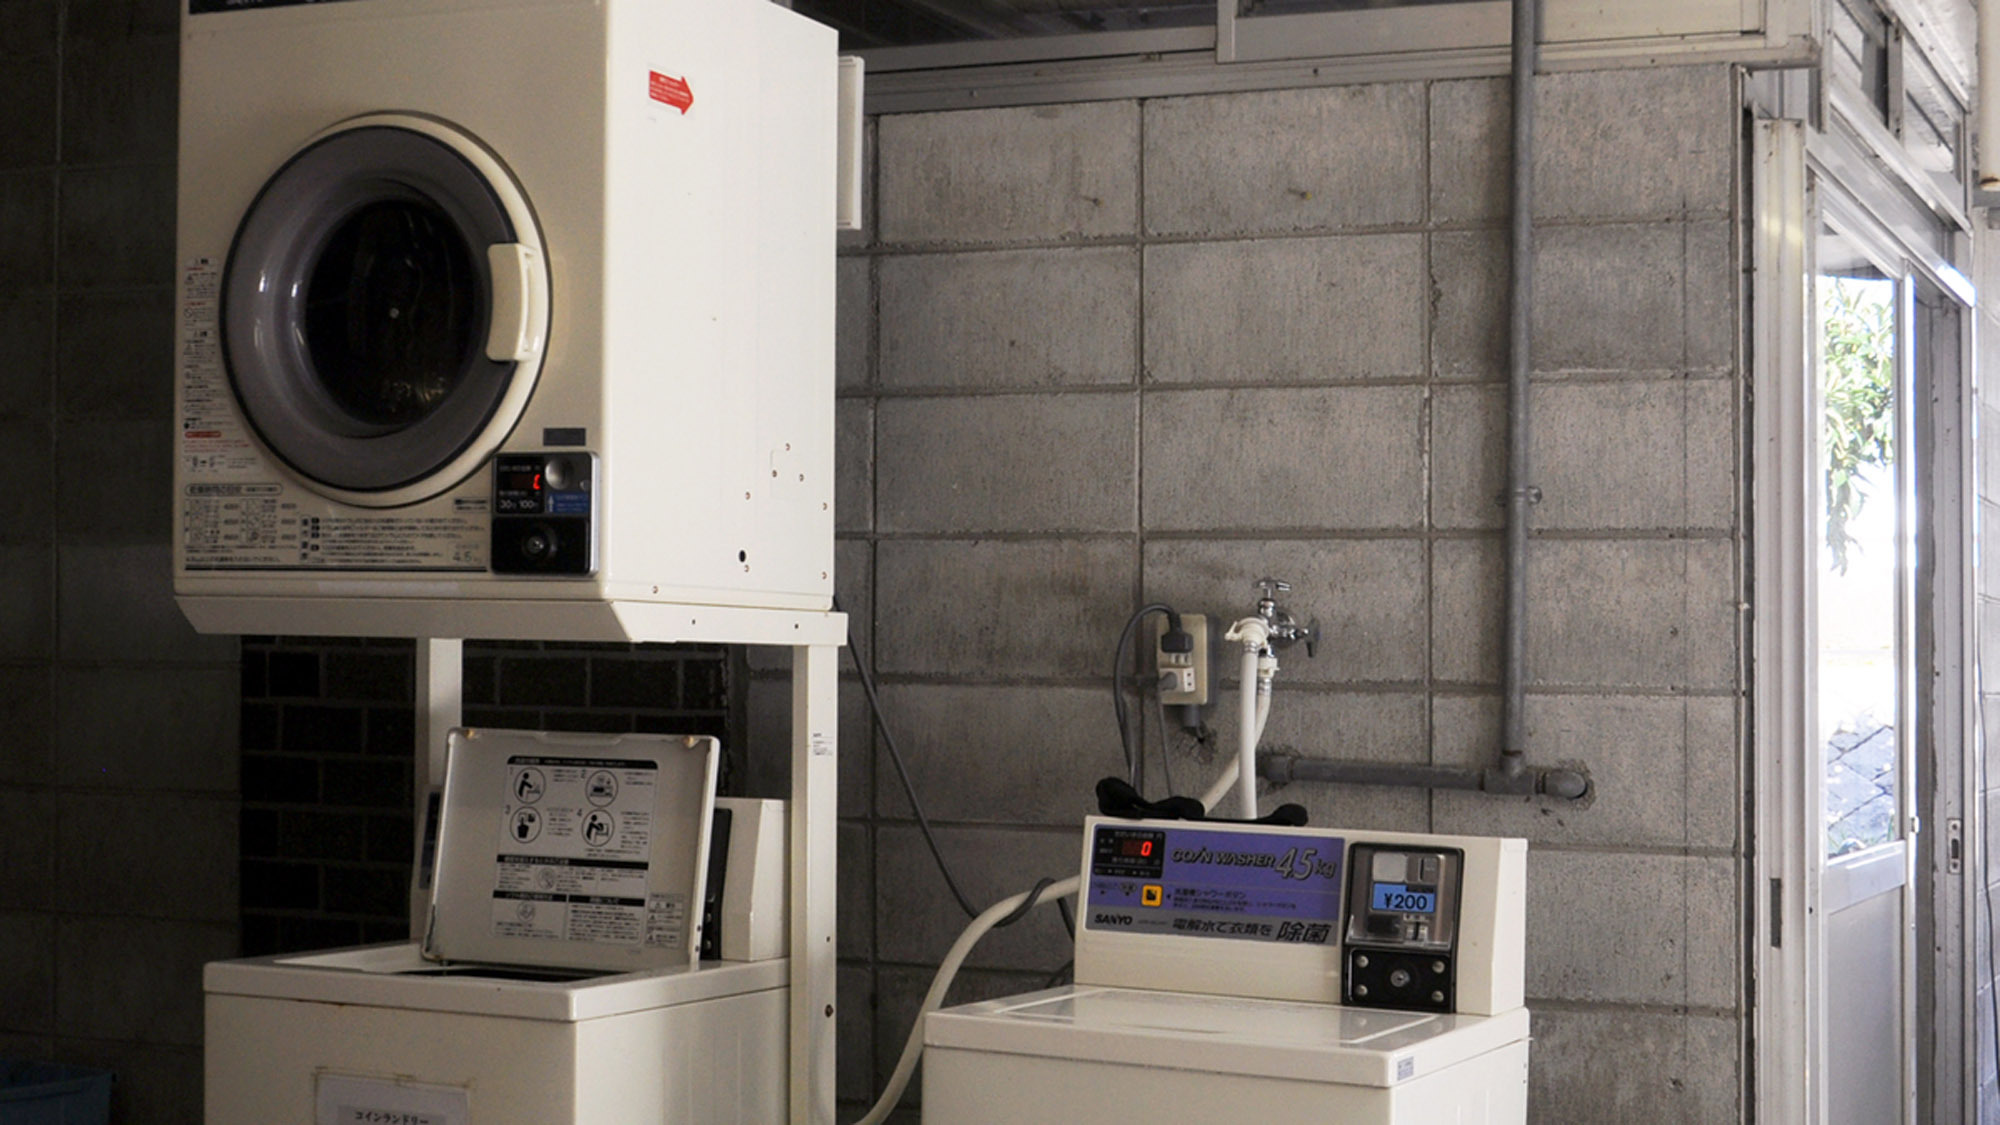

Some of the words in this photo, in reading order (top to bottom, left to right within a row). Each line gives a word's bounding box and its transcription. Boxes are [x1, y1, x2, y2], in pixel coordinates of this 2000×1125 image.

[1140, 840, 1153, 857] 0
[1172, 847, 1213, 865] COIN
[1215, 851, 1276, 868] WASHER
[1383, 892, 1428, 911] ¥200
[1094, 912, 1134, 926] SANYO
[1172, 917, 1274, 936] 電解水で衣類を
[1276, 920, 1331, 943] 除菌
[354, 1110, 429, 1125] コインランドリー
